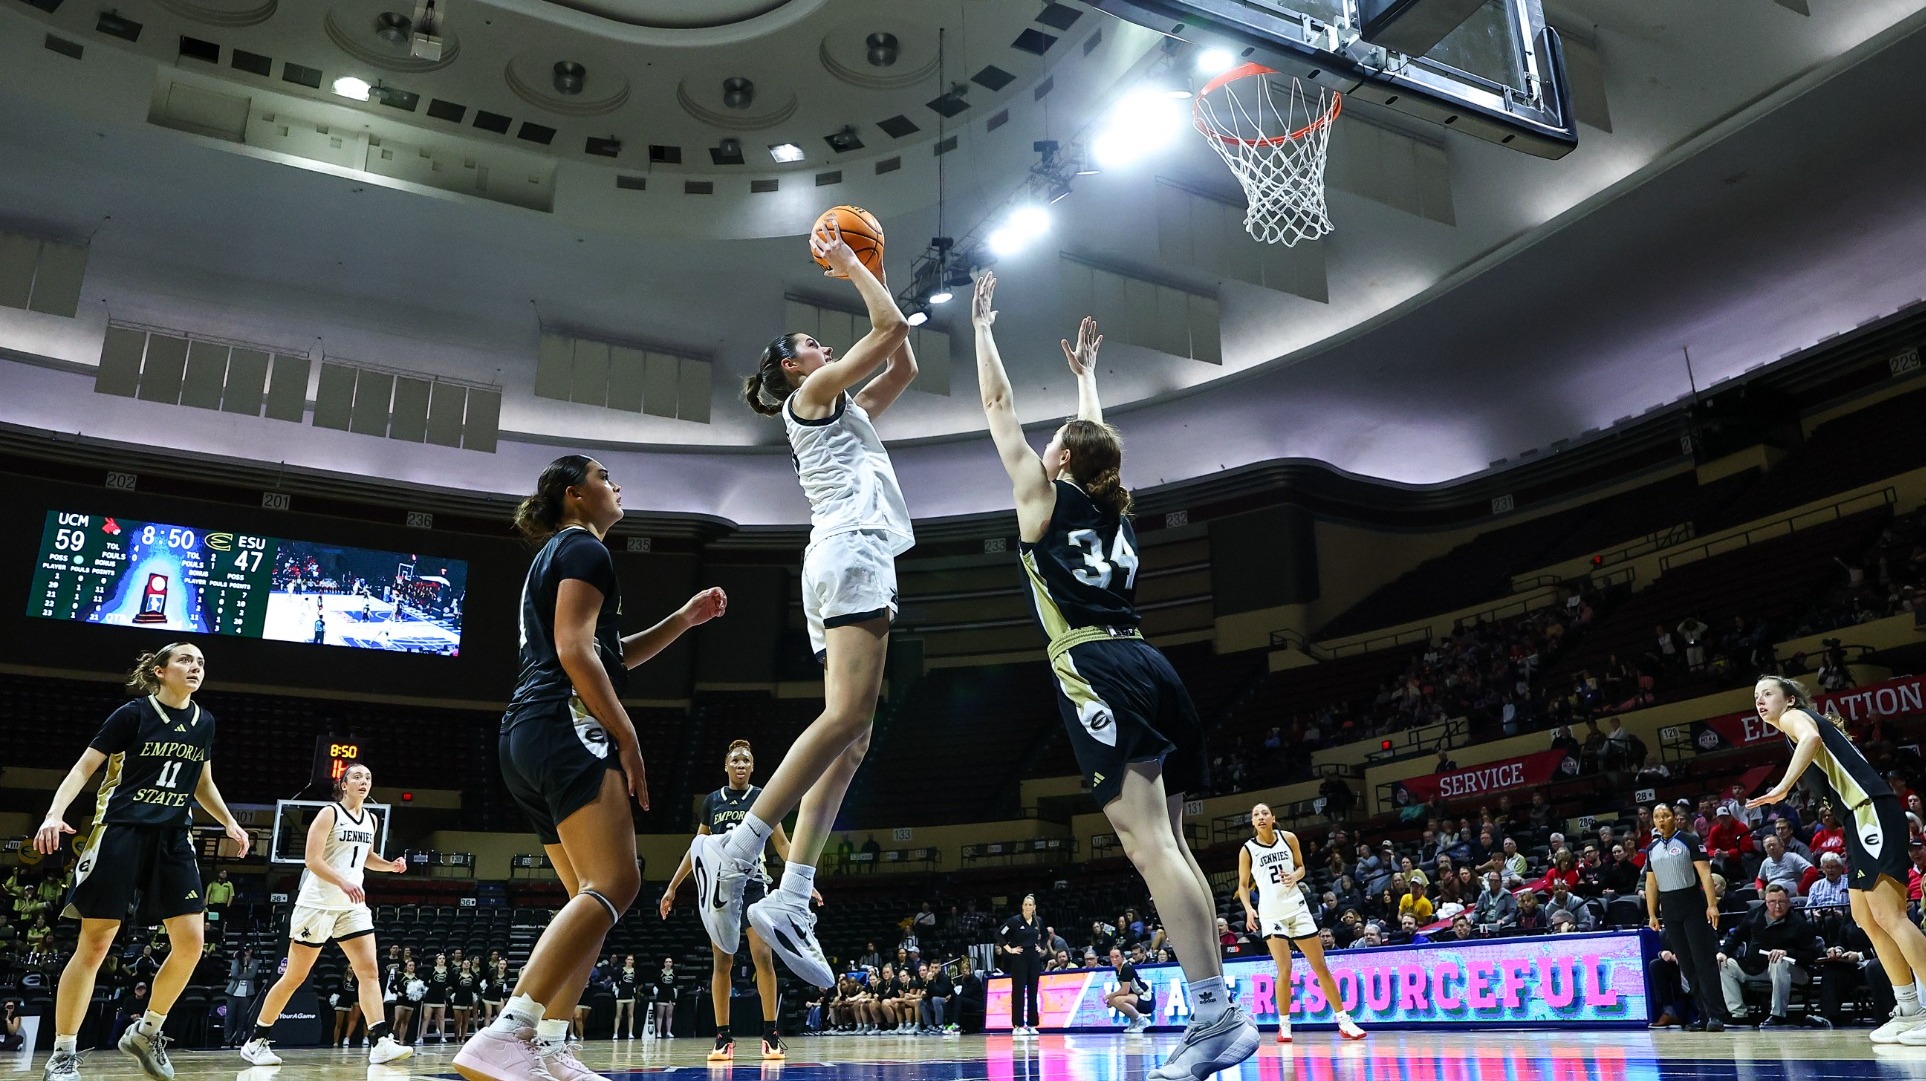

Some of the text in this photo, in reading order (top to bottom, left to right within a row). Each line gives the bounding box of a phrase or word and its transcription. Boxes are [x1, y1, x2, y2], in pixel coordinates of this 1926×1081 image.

[1891, 352, 1919, 374] 229
[107, 474, 136, 489] 202
[264, 493, 289, 508] 201
[1493, 496, 1514, 513] 231
[58, 512, 90, 527] UCM
[408, 513, 432, 528] 236
[1167, 512, 1188, 527] 232
[55, 528, 86, 552] 59
[141, 525, 195, 550] 8:50
[238, 535, 266, 550] ESU
[628, 538, 650, 551] 235
[106, 542, 140, 553] TOL 4
[985, 540, 1006, 553] 233
[49, 553, 69, 562] POSS
[94, 559, 116, 567] BONUS
[102, 551, 127, 560] FOULS
[186, 551, 217, 562] TOL 2
[234, 550, 264, 573] 47
[1067, 523, 1140, 591] 34
[42, 562, 116, 576] PLAYER FOULS POINTS
[181, 560, 216, 570] FOULS 1
[188, 569, 209, 577] BONUS
[227, 573, 245, 581] POSS
[184, 577, 251, 590] PLAYER FOULS POINTS
[1741, 681, 1923, 743] EDATION
[1664, 727, 1678, 739] 128
[140, 741, 205, 762] EMPORIA
[330, 743, 358, 759] 8:50
[155, 760, 183, 789] 11
[1439, 762, 1525, 798] SERVICE
[132, 788, 189, 807] STATE
[1187, 802, 1203, 815] 131
[713, 810, 746, 825] EMPOR
[894, 829, 912, 841] 133
[350, 845, 359, 868] 1
[1259, 850, 1290, 867] JENNIES
[1251, 953, 1619, 1015] RESOURCEFUL
